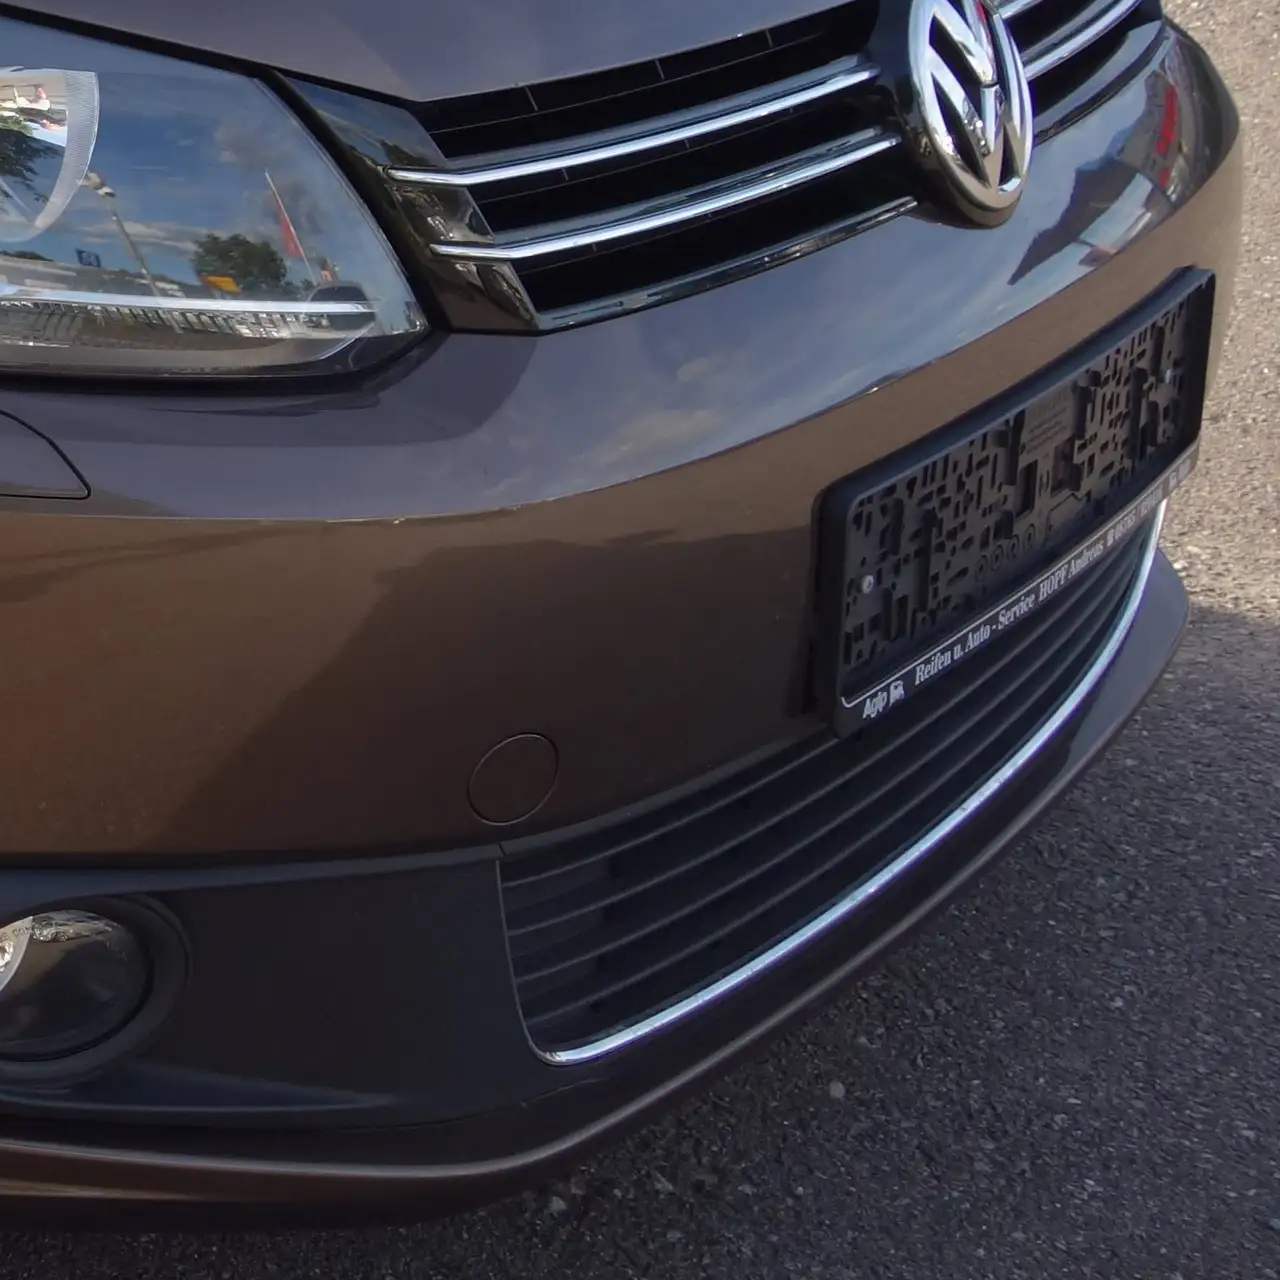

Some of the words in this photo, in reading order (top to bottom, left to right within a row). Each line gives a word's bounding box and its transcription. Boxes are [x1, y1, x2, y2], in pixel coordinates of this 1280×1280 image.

[863, 691, 888, 718] Agip
[915, 650, 952, 686] Reifen
[998, 593, 1036, 630] Service
[1039, 564, 1069, 603] HOPF
